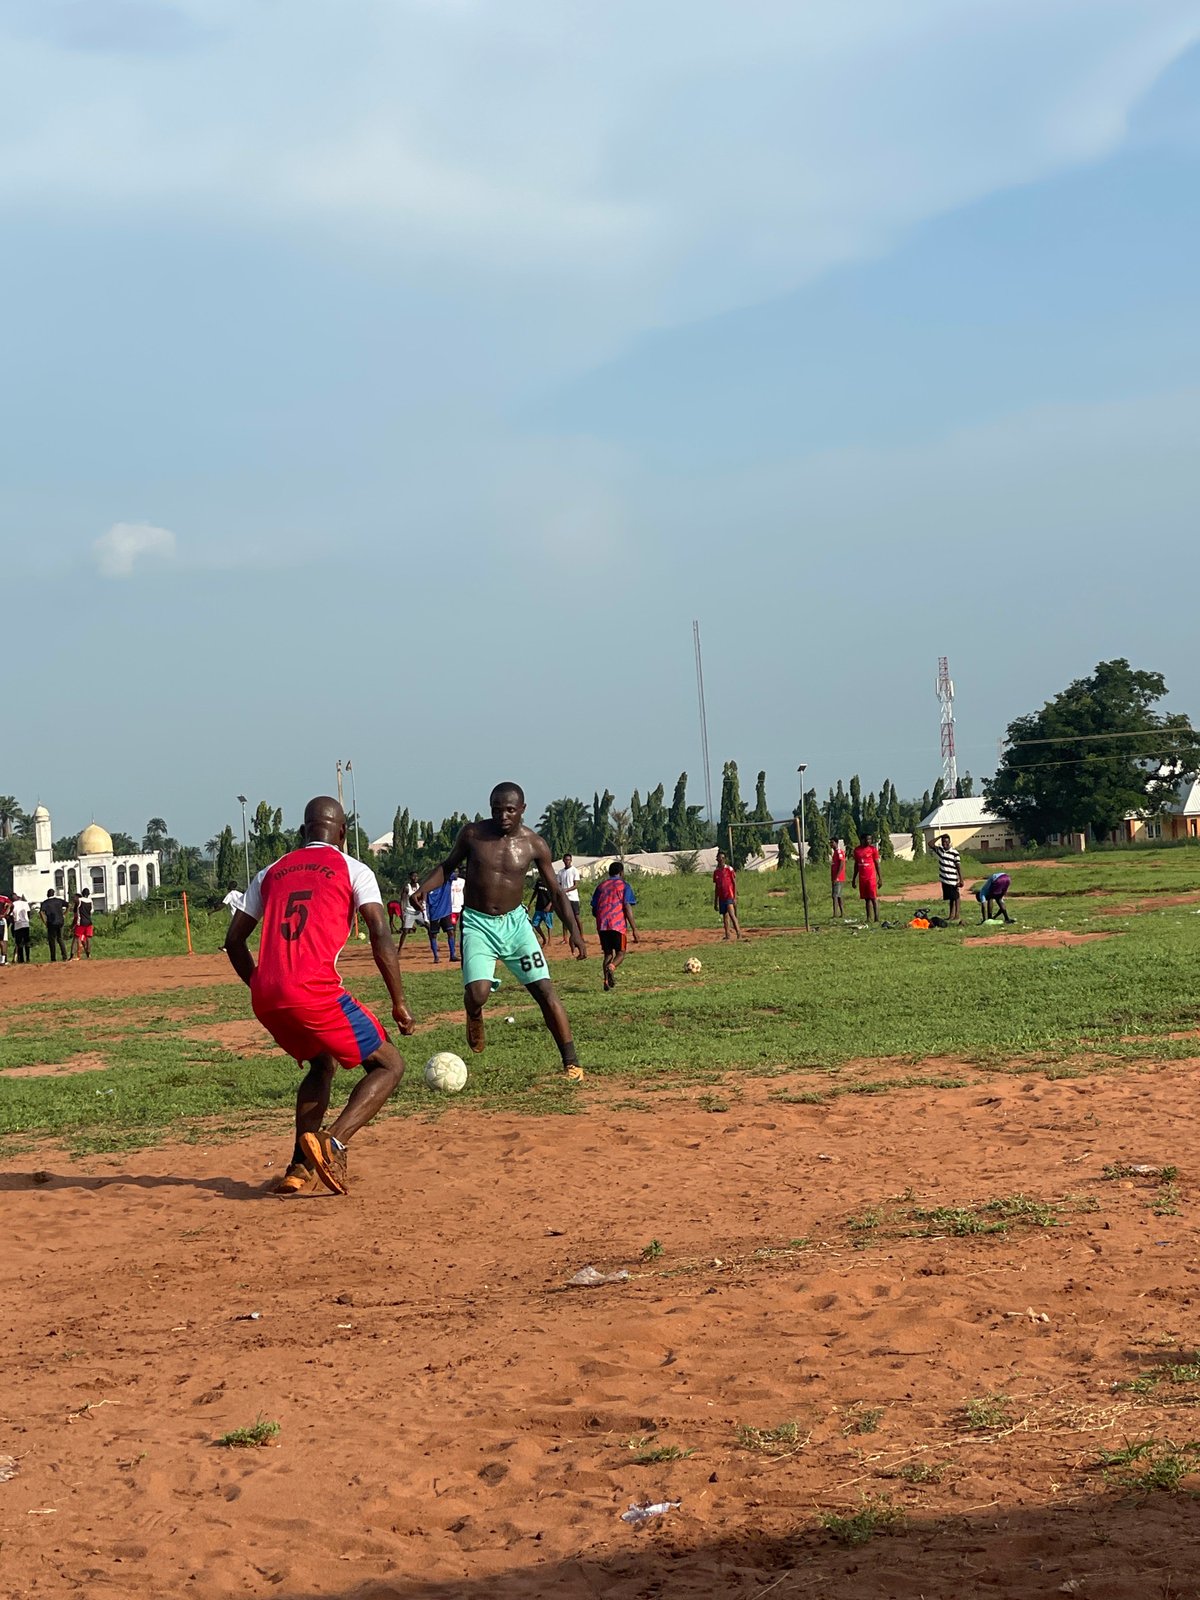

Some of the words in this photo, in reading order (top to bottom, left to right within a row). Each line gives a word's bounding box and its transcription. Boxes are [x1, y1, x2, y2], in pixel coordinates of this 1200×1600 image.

[319, 866, 336, 879] FC
[280, 890, 313, 940] 5
[519, 951, 545, 972] 68
